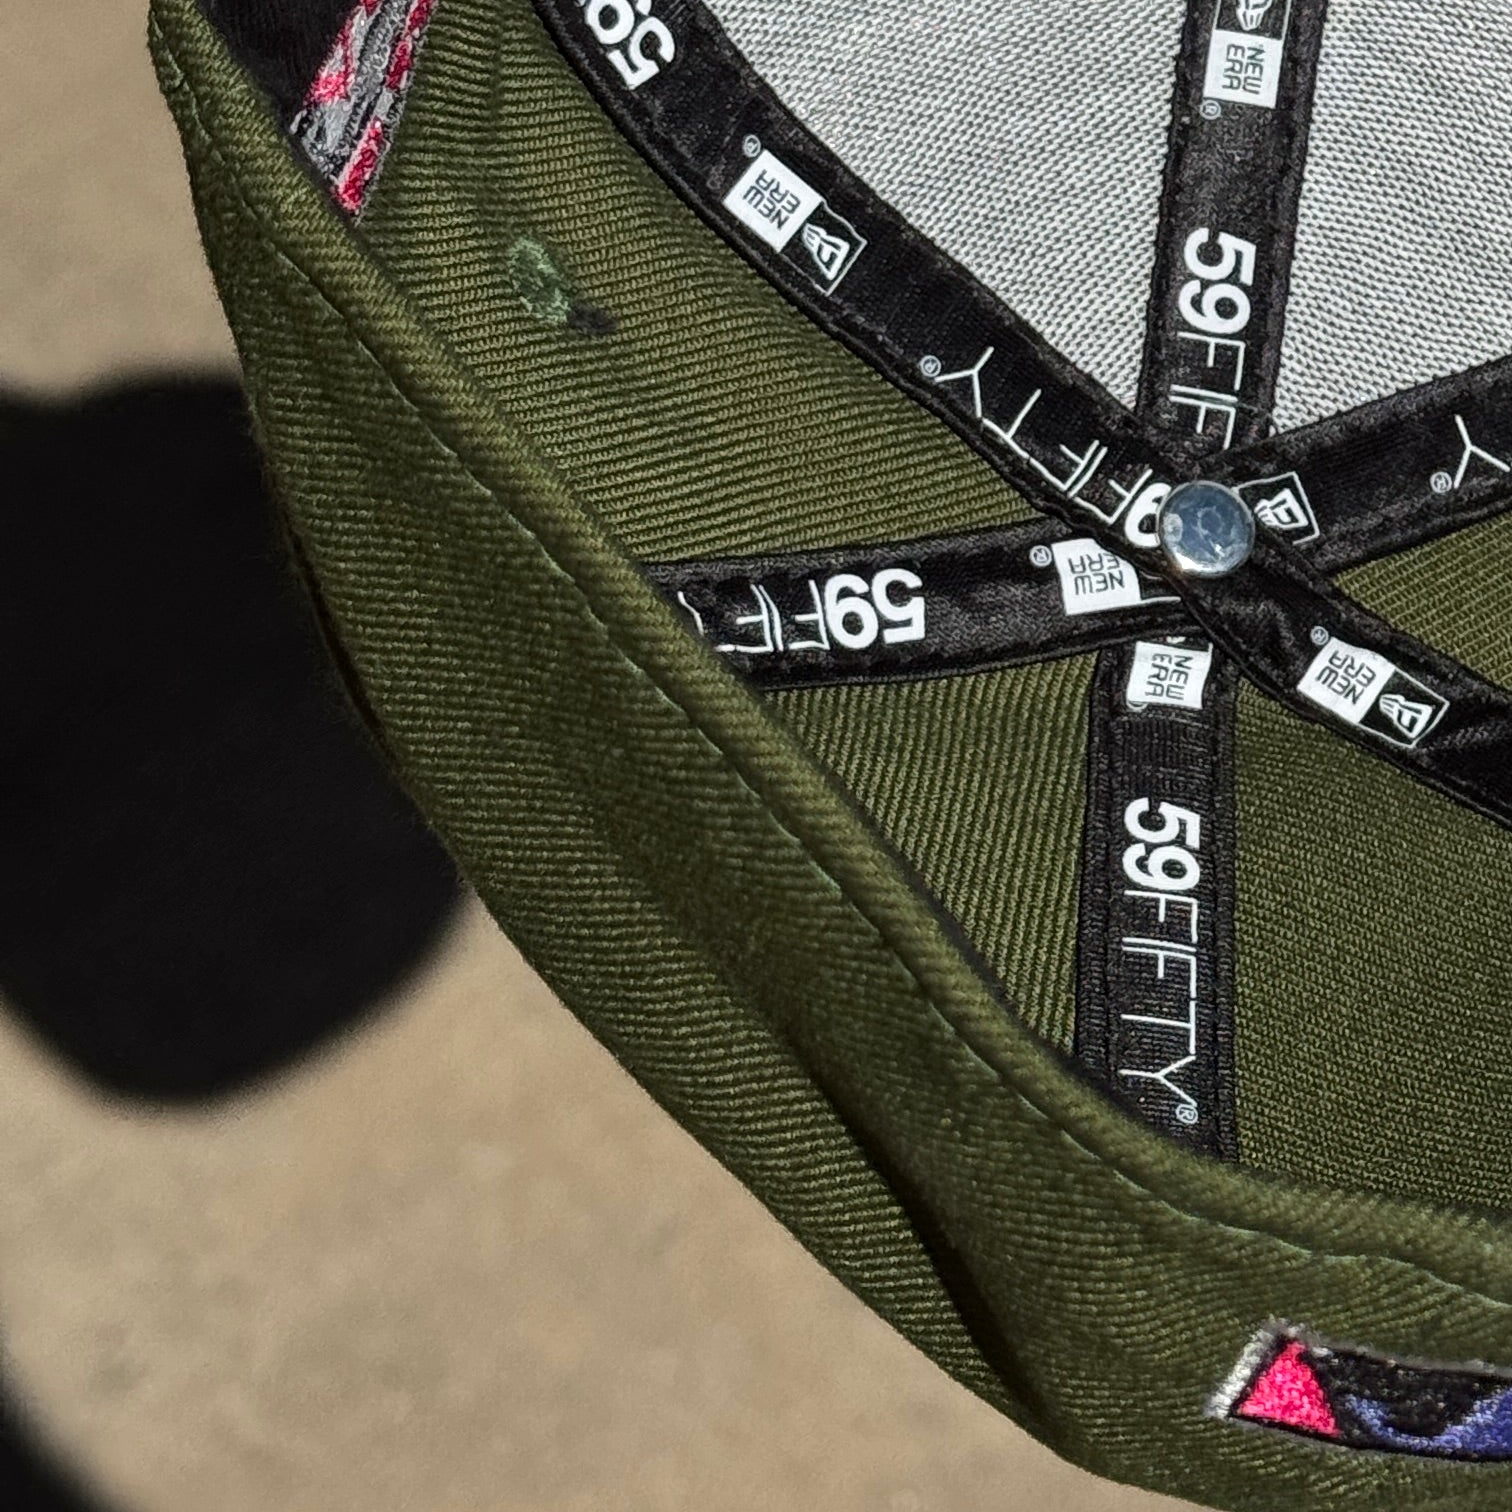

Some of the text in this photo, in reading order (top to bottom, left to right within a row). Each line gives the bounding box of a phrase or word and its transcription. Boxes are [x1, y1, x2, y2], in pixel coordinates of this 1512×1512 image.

[1221, 43, 1246, 90] ERA
[1242, 46, 1266, 95] NEW
[742, 185, 790, 230] NEW
[755, 169, 801, 214] ERA
[1169, 227, 1257, 451] 59FIF
[1068, 552, 1120, 575] ERA
[1074, 570, 1125, 596] NEW
[1144, 652, 1173, 698] ERA
[1166, 654, 1194, 700] NEW
[1315, 666, 1365, 705] NEW
[1328, 650, 1376, 688] ERA
